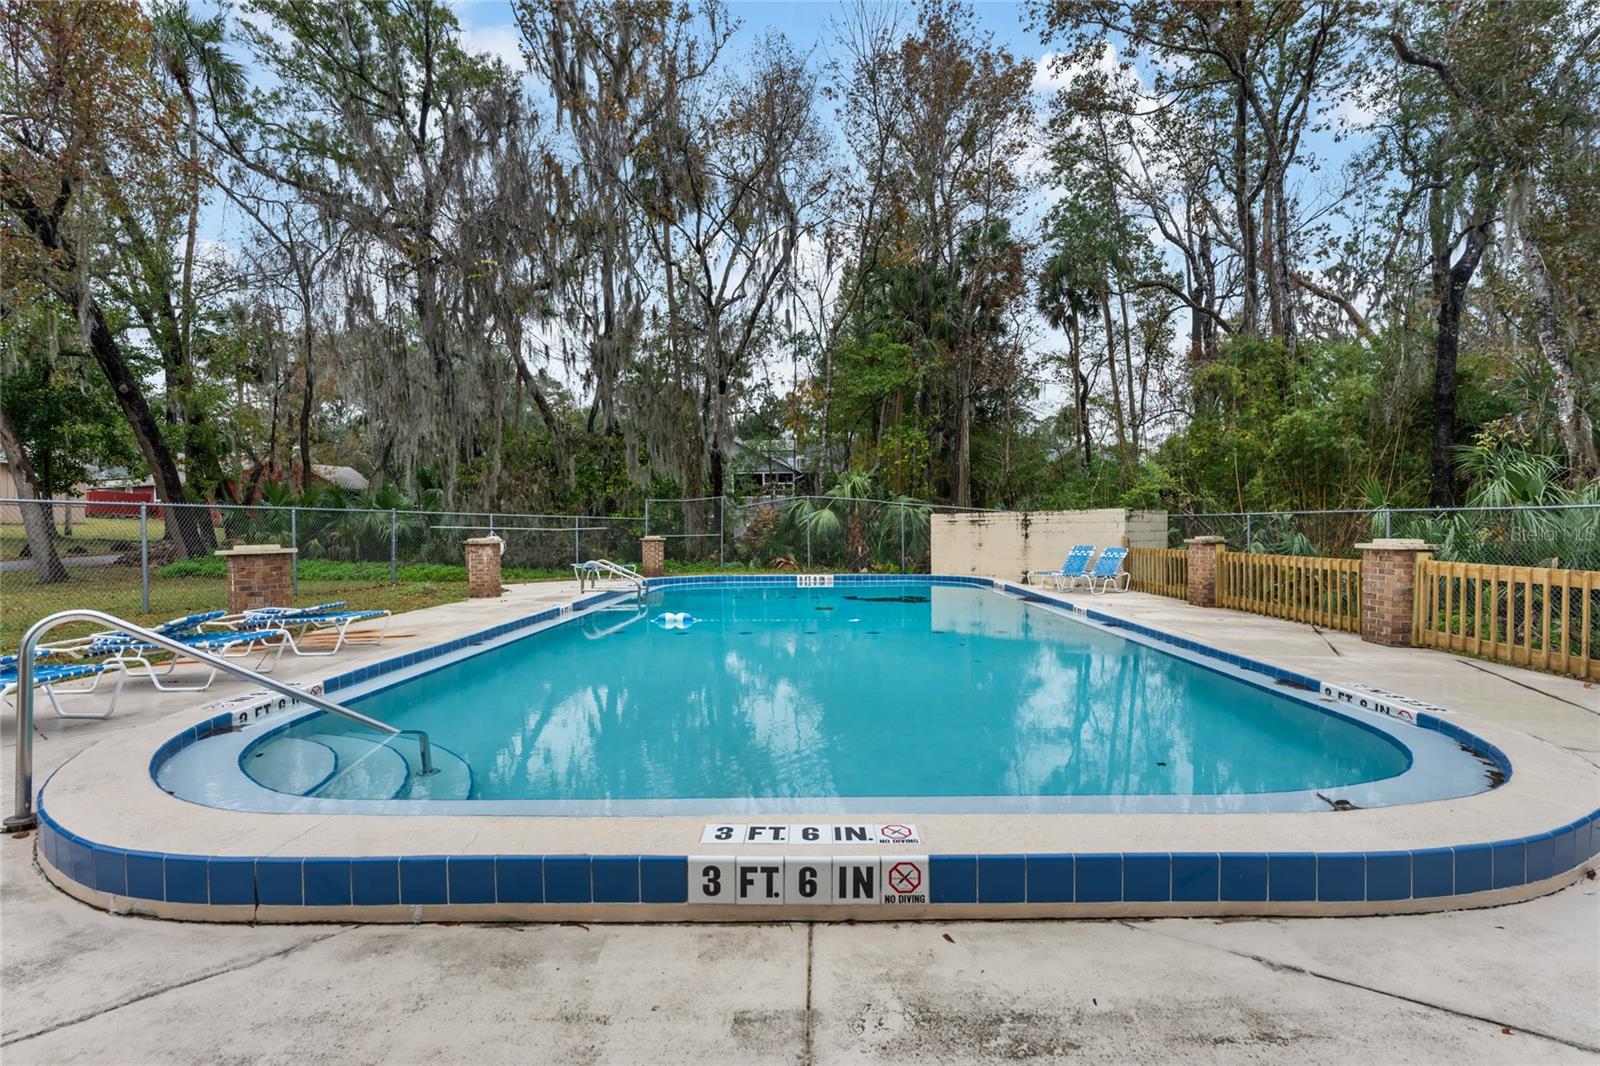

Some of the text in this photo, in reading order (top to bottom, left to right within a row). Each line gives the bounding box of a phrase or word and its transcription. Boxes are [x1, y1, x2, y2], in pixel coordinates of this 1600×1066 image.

[715, 826, 874, 841] 3 FT. 6 IN.
[702, 865, 874, 899] 3 FT. 6 IN
[884, 894, 926, 904] NO DIVING
